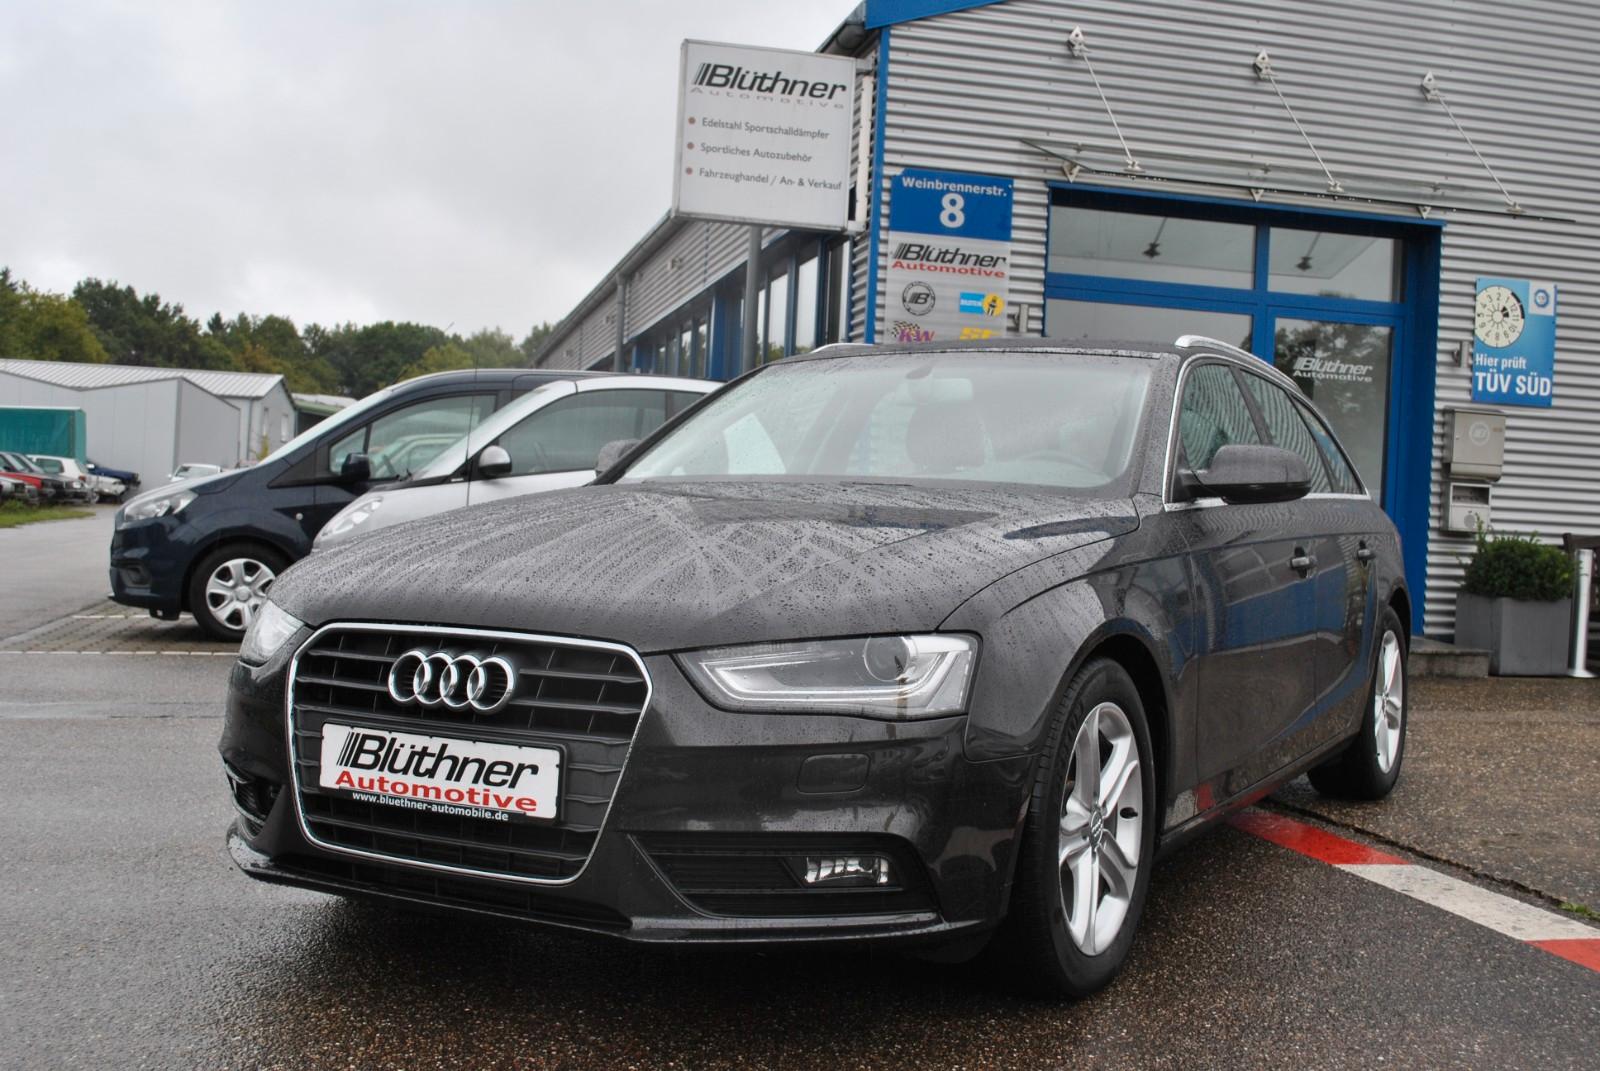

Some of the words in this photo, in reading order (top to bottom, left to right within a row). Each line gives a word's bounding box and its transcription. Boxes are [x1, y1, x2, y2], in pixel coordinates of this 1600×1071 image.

[705, 63, 847, 100] Blüthner
[690, 87, 845, 109] Automotive
[702, 117, 742, 130] Edelstahl
[744, 122, 830, 140] Sportschalldämpfer
[700, 143, 750, 158] Sportliches
[753, 149, 813, 163] Autozubehör
[699, 167, 769, 184] Fahrzeughandel
[770, 175, 777, 186] /
[779, 175, 796, 186] An-
[797, 178, 805, 187] &
[807, 179, 842, 191] Verkauf
[901, 176, 1007, 197] Weinbrennerstr.
[939, 192, 966, 229] 8
[901, 243, 1007, 268] Blüthner
[892, 260, 1006, 279] Automotive
[1299, 357, 1373, 375] Blüthner
[1475, 353, 1499, 367] Hier
[1501, 356, 1527, 371] prüft
[1293, 370, 1373, 383] Automotive
[1475, 368, 1512, 393] TÜV
[1515, 372, 1551, 397] SÜD
[350, 733, 539, 789] Blüthner
[335, 770, 537, 812] Automotive
[351, 790, 509, 822] www.bluethner-automobile.de
